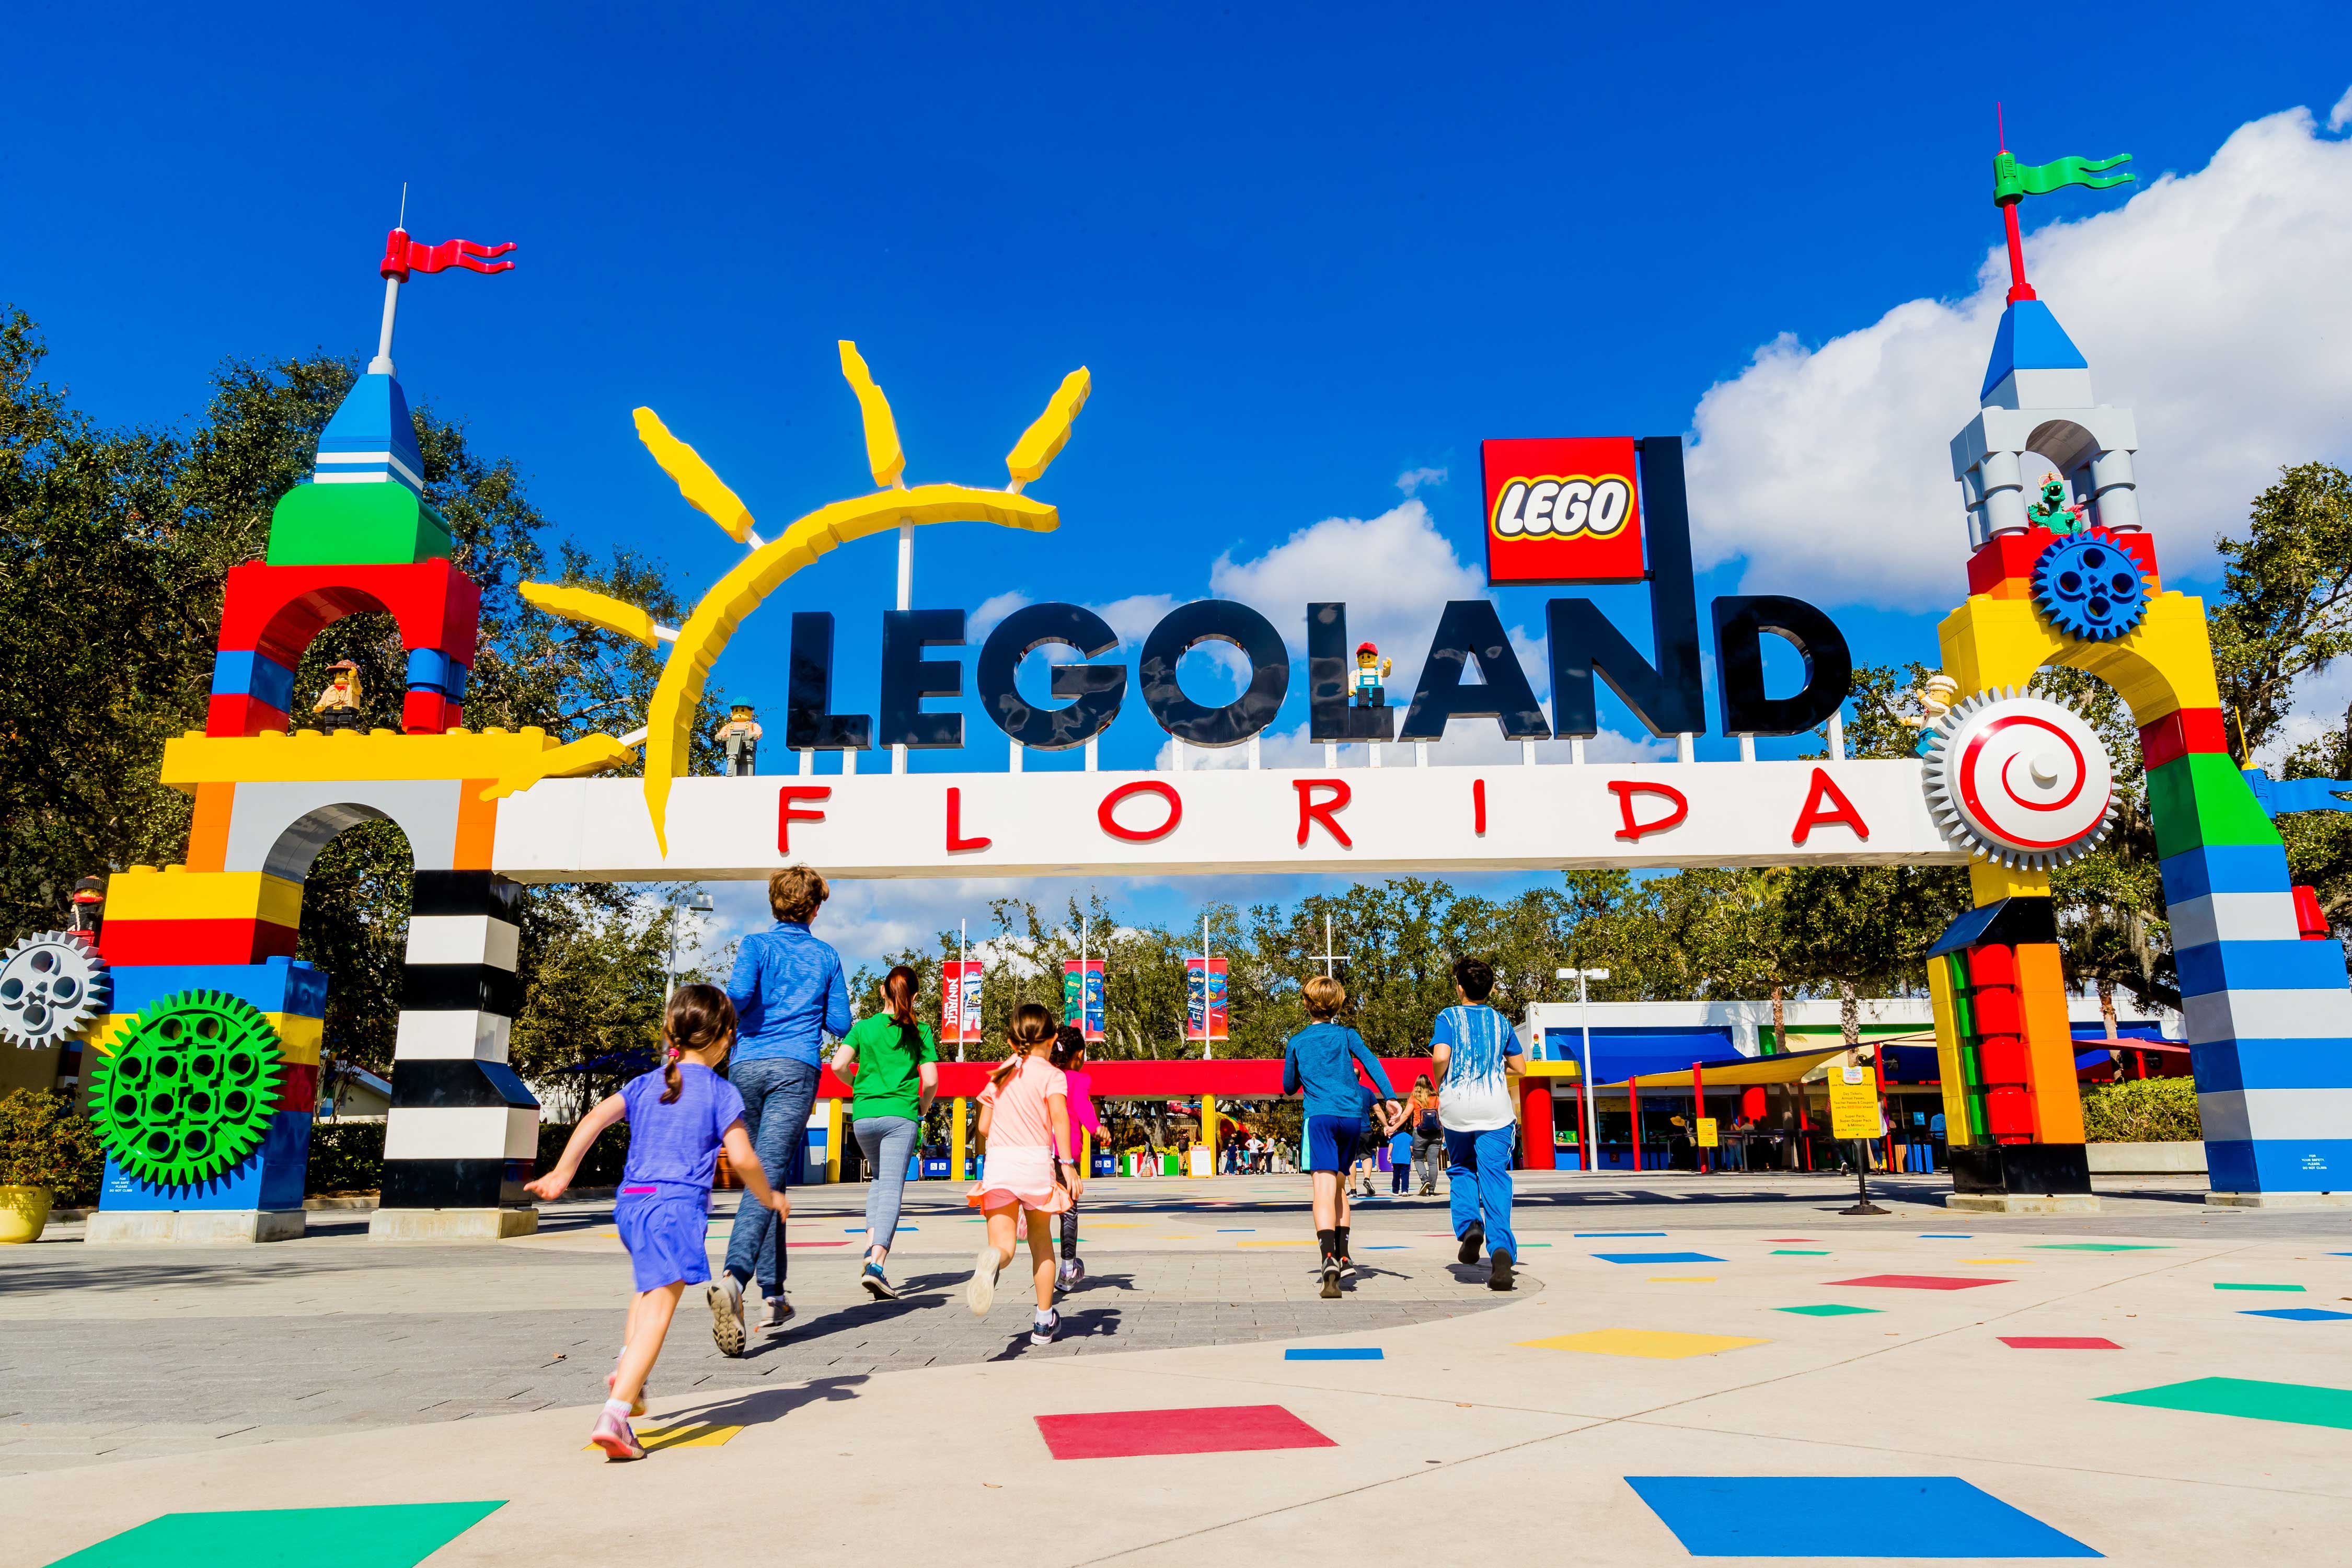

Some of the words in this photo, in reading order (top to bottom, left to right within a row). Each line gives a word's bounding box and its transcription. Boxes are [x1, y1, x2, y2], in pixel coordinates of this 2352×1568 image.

[1495, 478, 1630, 537] LEGO
[786, 595, 1852, 751] LEGOLAND
[778, 767, 1869, 856] FLORIDA
[945, 976, 959, 1027] NINJAGO
[1571, 1133, 1575, 1142] 1
